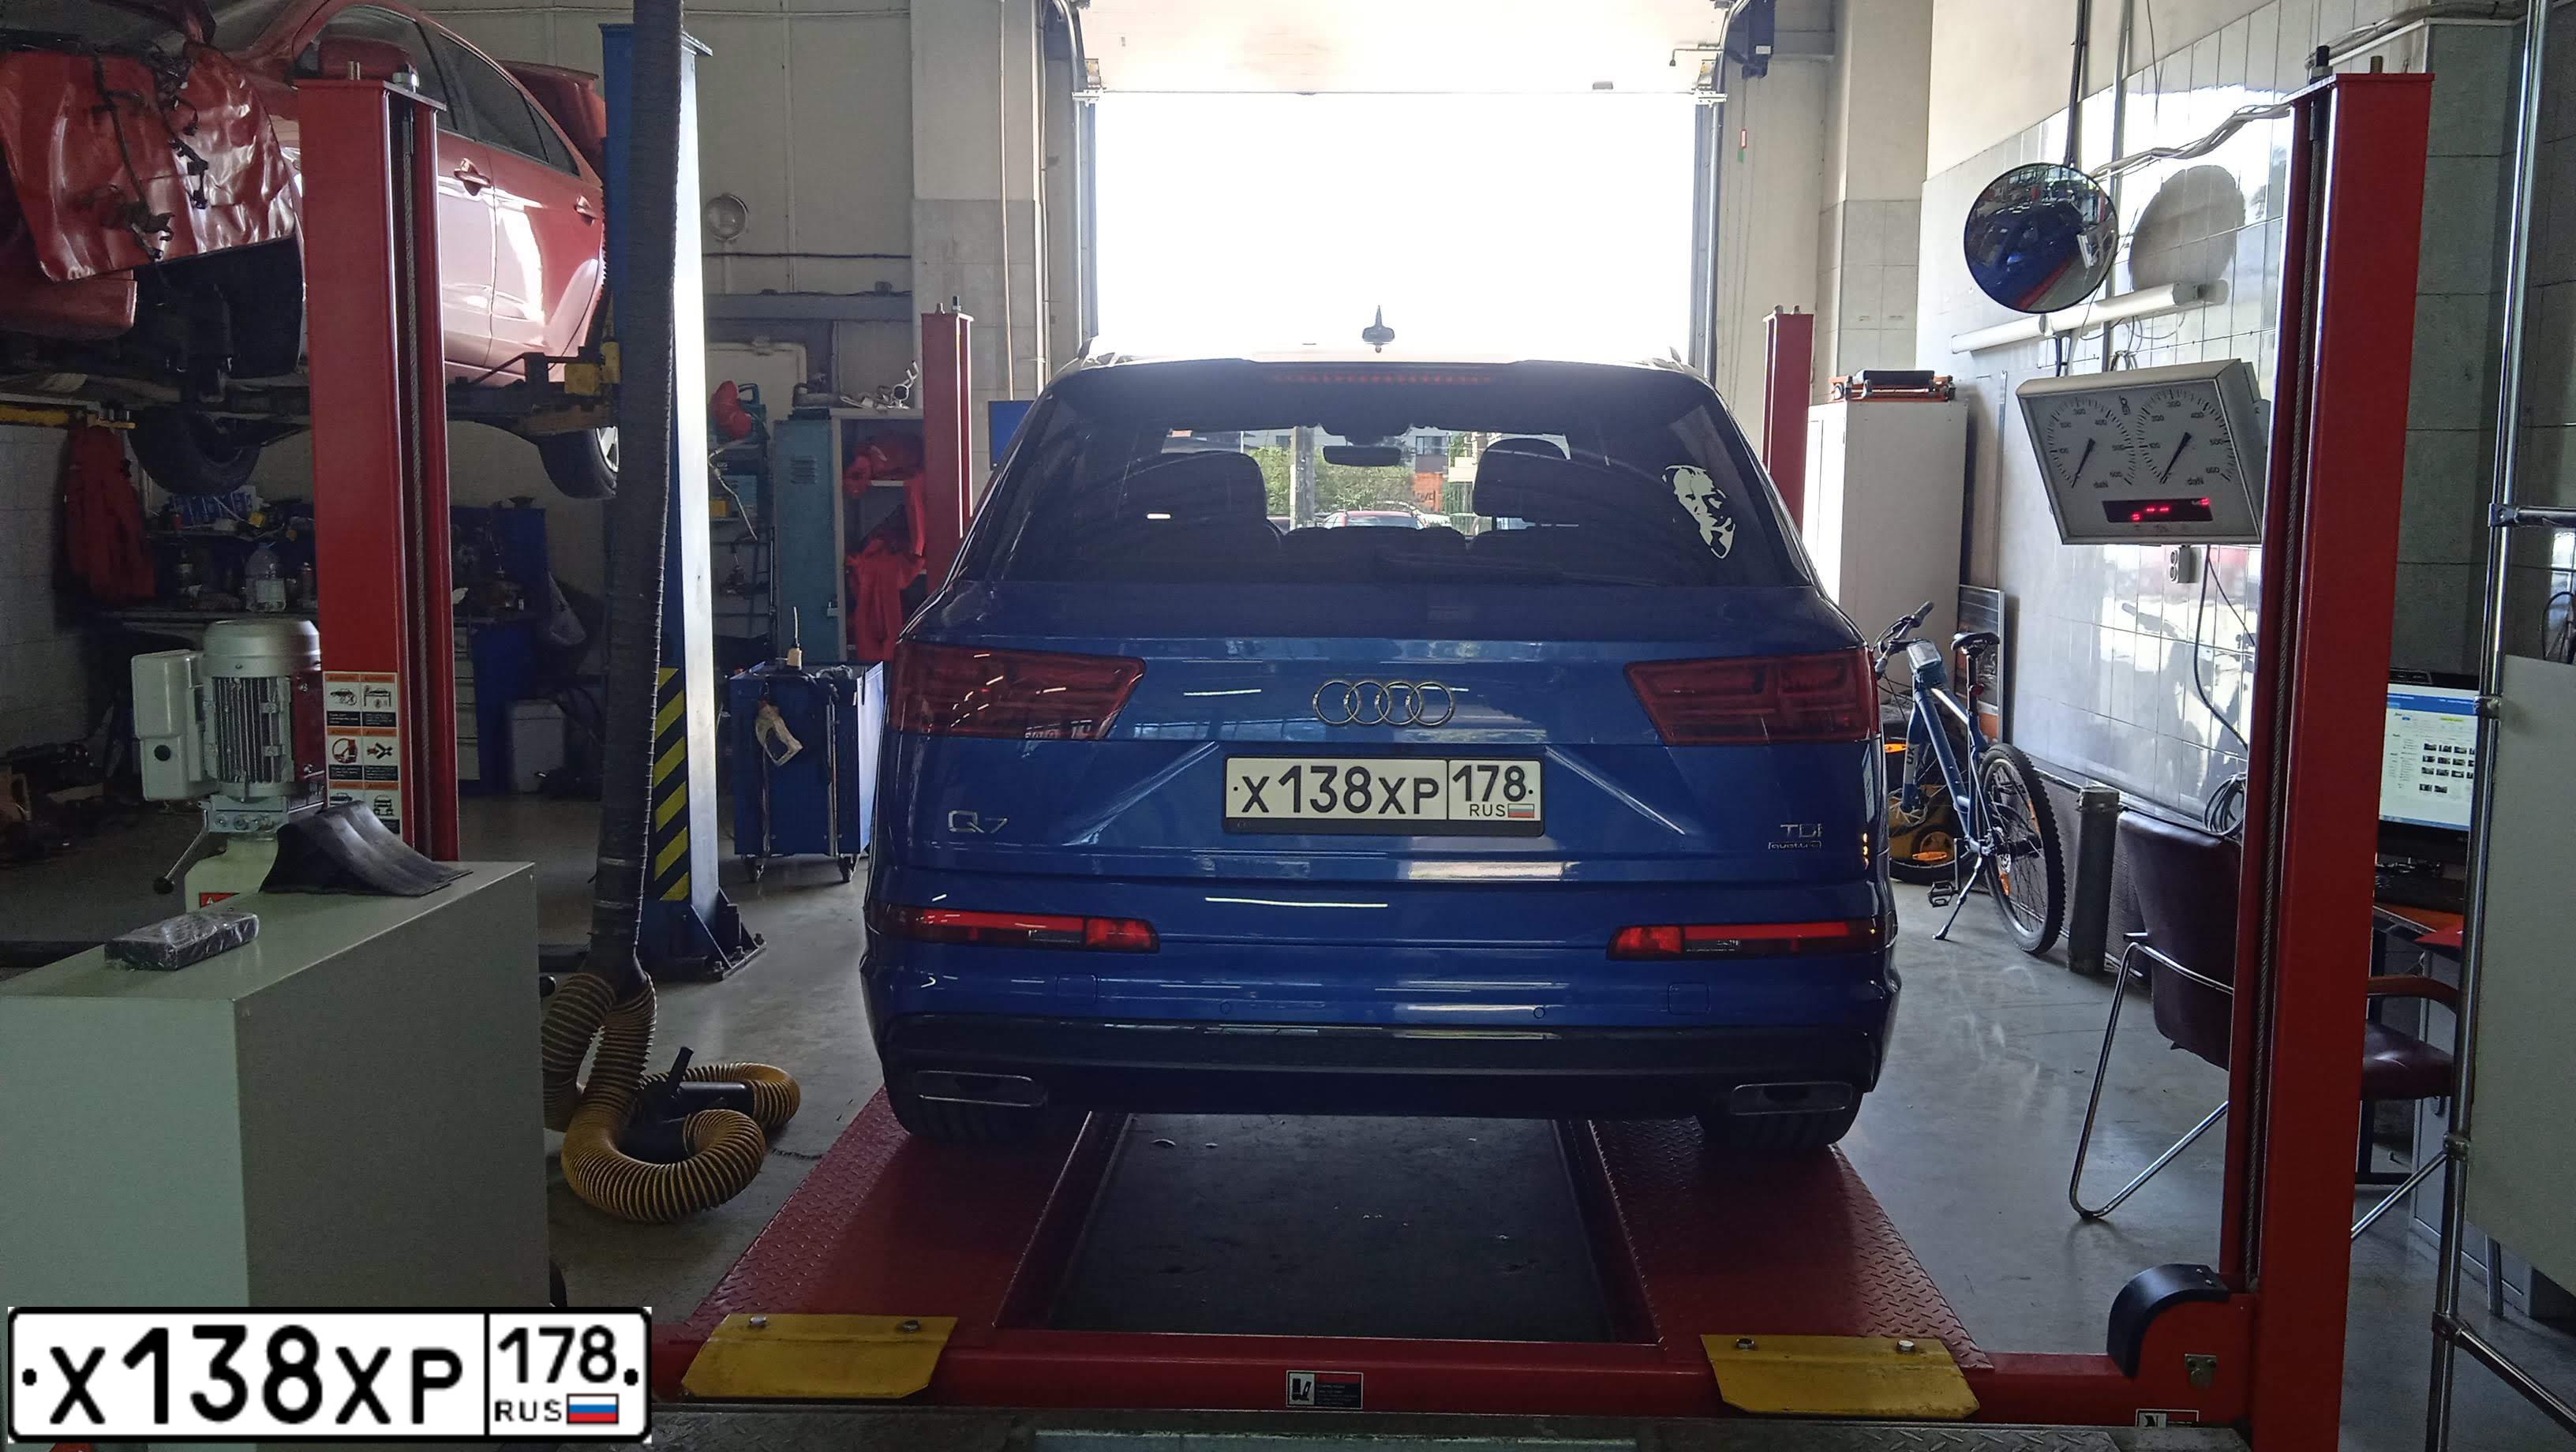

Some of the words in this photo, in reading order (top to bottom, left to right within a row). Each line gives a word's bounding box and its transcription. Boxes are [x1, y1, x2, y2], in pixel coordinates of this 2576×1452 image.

[1452, 765, 1526, 802] 178
[948, 810, 1008, 833] Q7
[1470, 804, 1505, 817] RUS
